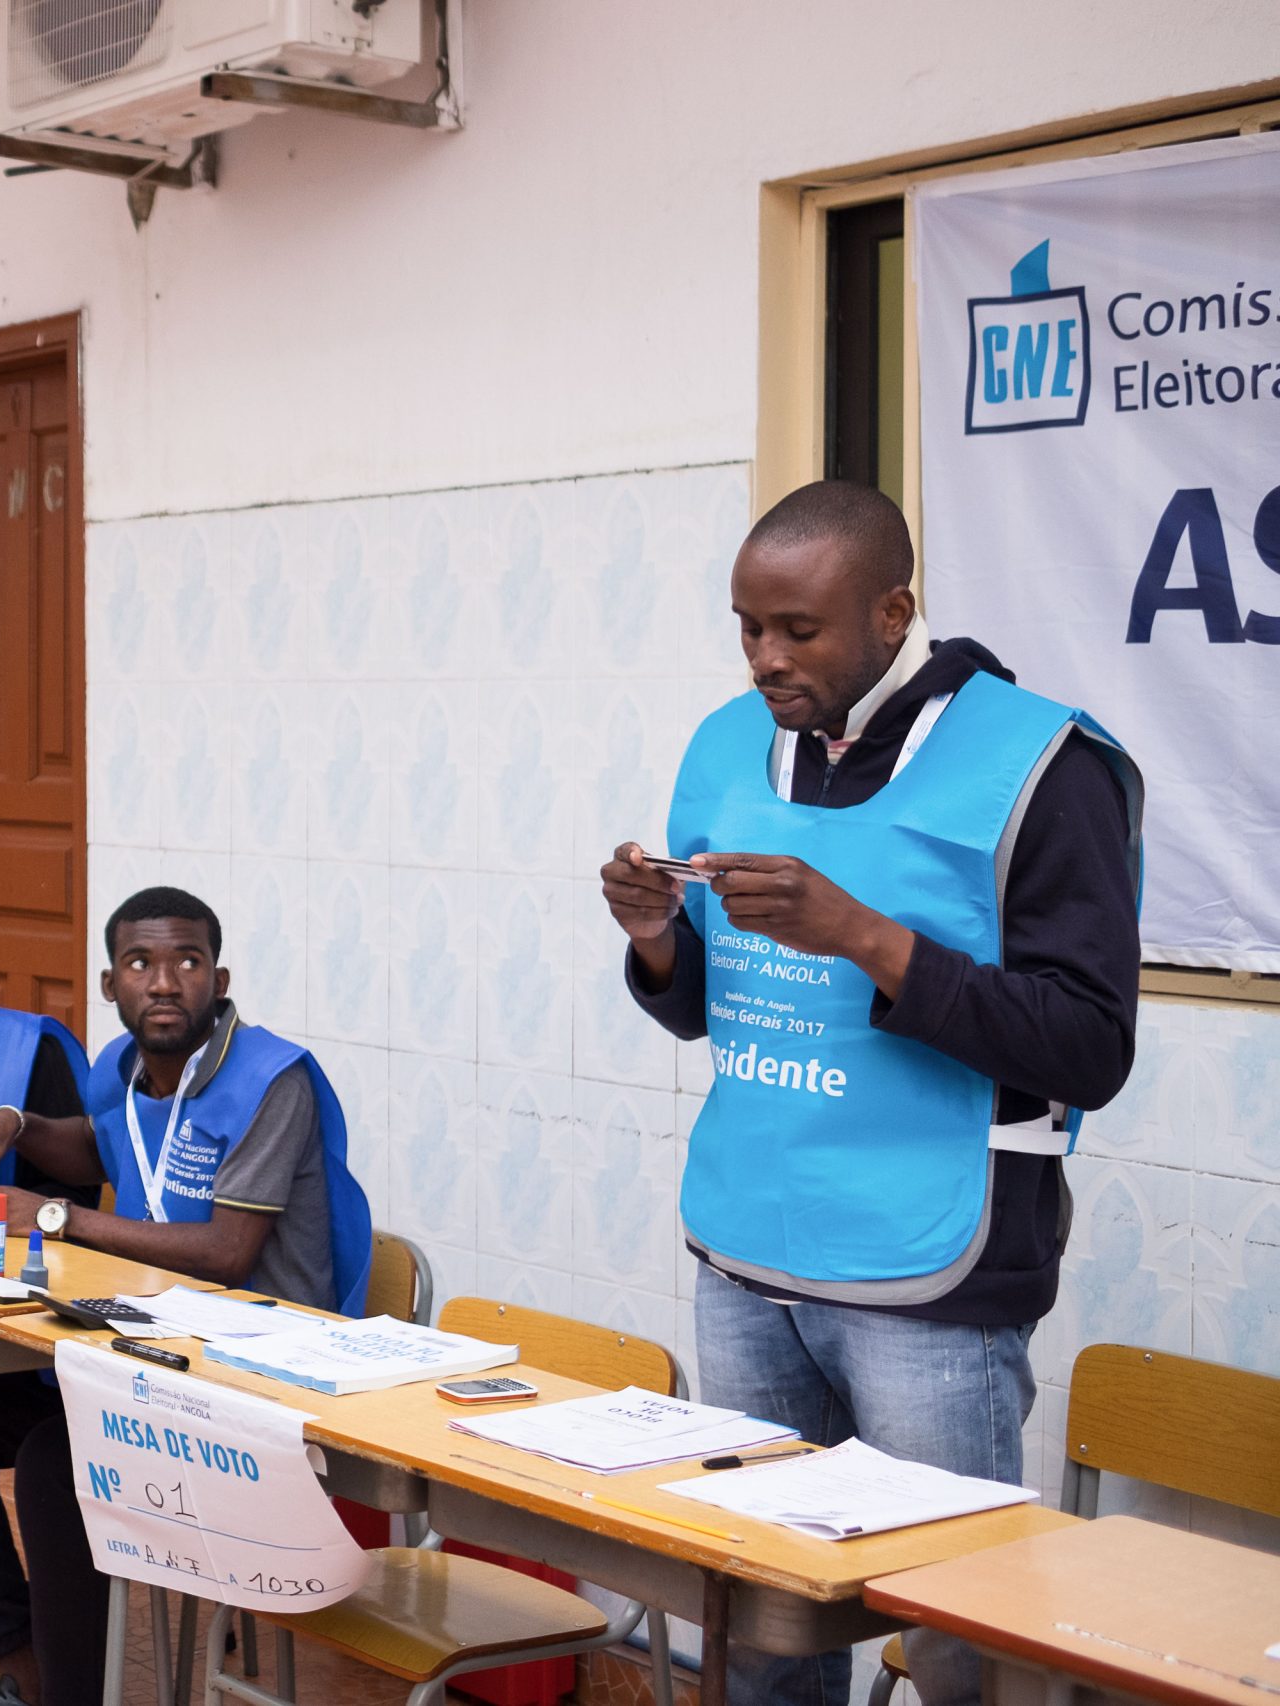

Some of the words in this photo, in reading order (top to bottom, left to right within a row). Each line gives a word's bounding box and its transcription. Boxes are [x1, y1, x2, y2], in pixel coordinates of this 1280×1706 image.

[1107, 281, 1280, 341] Comis
[982, 318, 1077, 404] CNE
[711, 930, 770, 954] Comissão
[711, 951, 750, 972] Eleitoral
[759, 961, 831, 986] ANGOLA
[767, 1000, 795, 1013] Angola
[738, 1009, 782, 1030] Gerais
[786, 1018, 825, 1037] 2017
[180, 1151, 216, 1164] ANGOLA
[185, 1143, 218, 1156] Nacional
[180, 1404, 211, 1420] ANGOLA
[182, 1393, 210, 1408] Nacional
[102, 1410, 161, 1453] MESA
[164, 1428, 194, 1463] DE
[196, 1437, 259, 1482] VOTO
[88, 1462, 122, 1502] Nº
[145, 1482, 198, 1519] 01
[107, 1539, 140, 1557] LETRA
[229, 1573, 239, 1585] A
[249, 1572, 325, 1596] 1030
